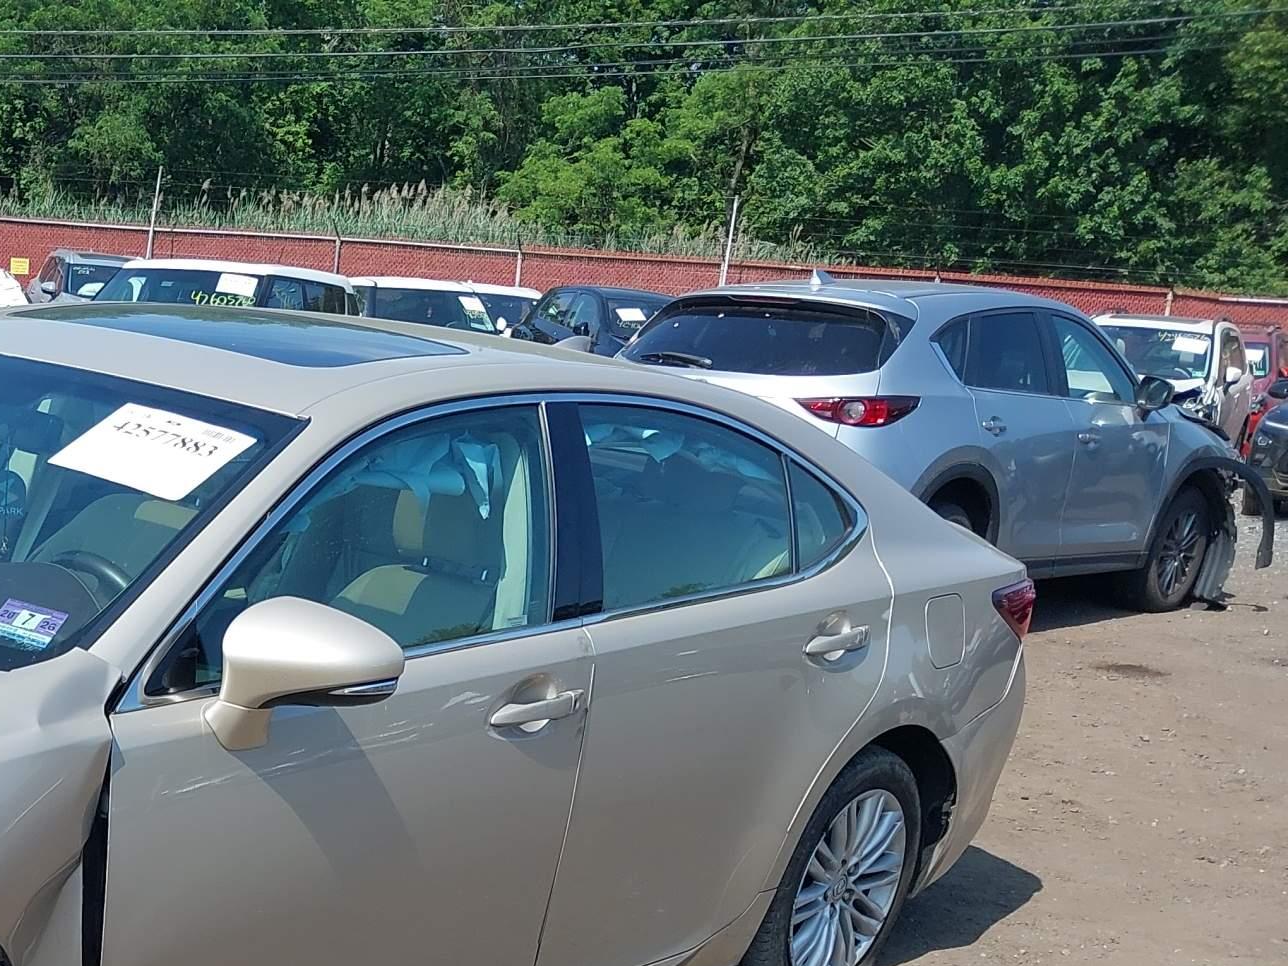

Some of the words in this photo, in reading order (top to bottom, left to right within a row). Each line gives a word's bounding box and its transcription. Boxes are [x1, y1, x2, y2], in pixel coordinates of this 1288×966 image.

[113, 421, 219, 457] 42577883
[0, 609, 17, 620] 20
[21, 613, 37, 626] 7
[39, 620, 57, 632] 26
